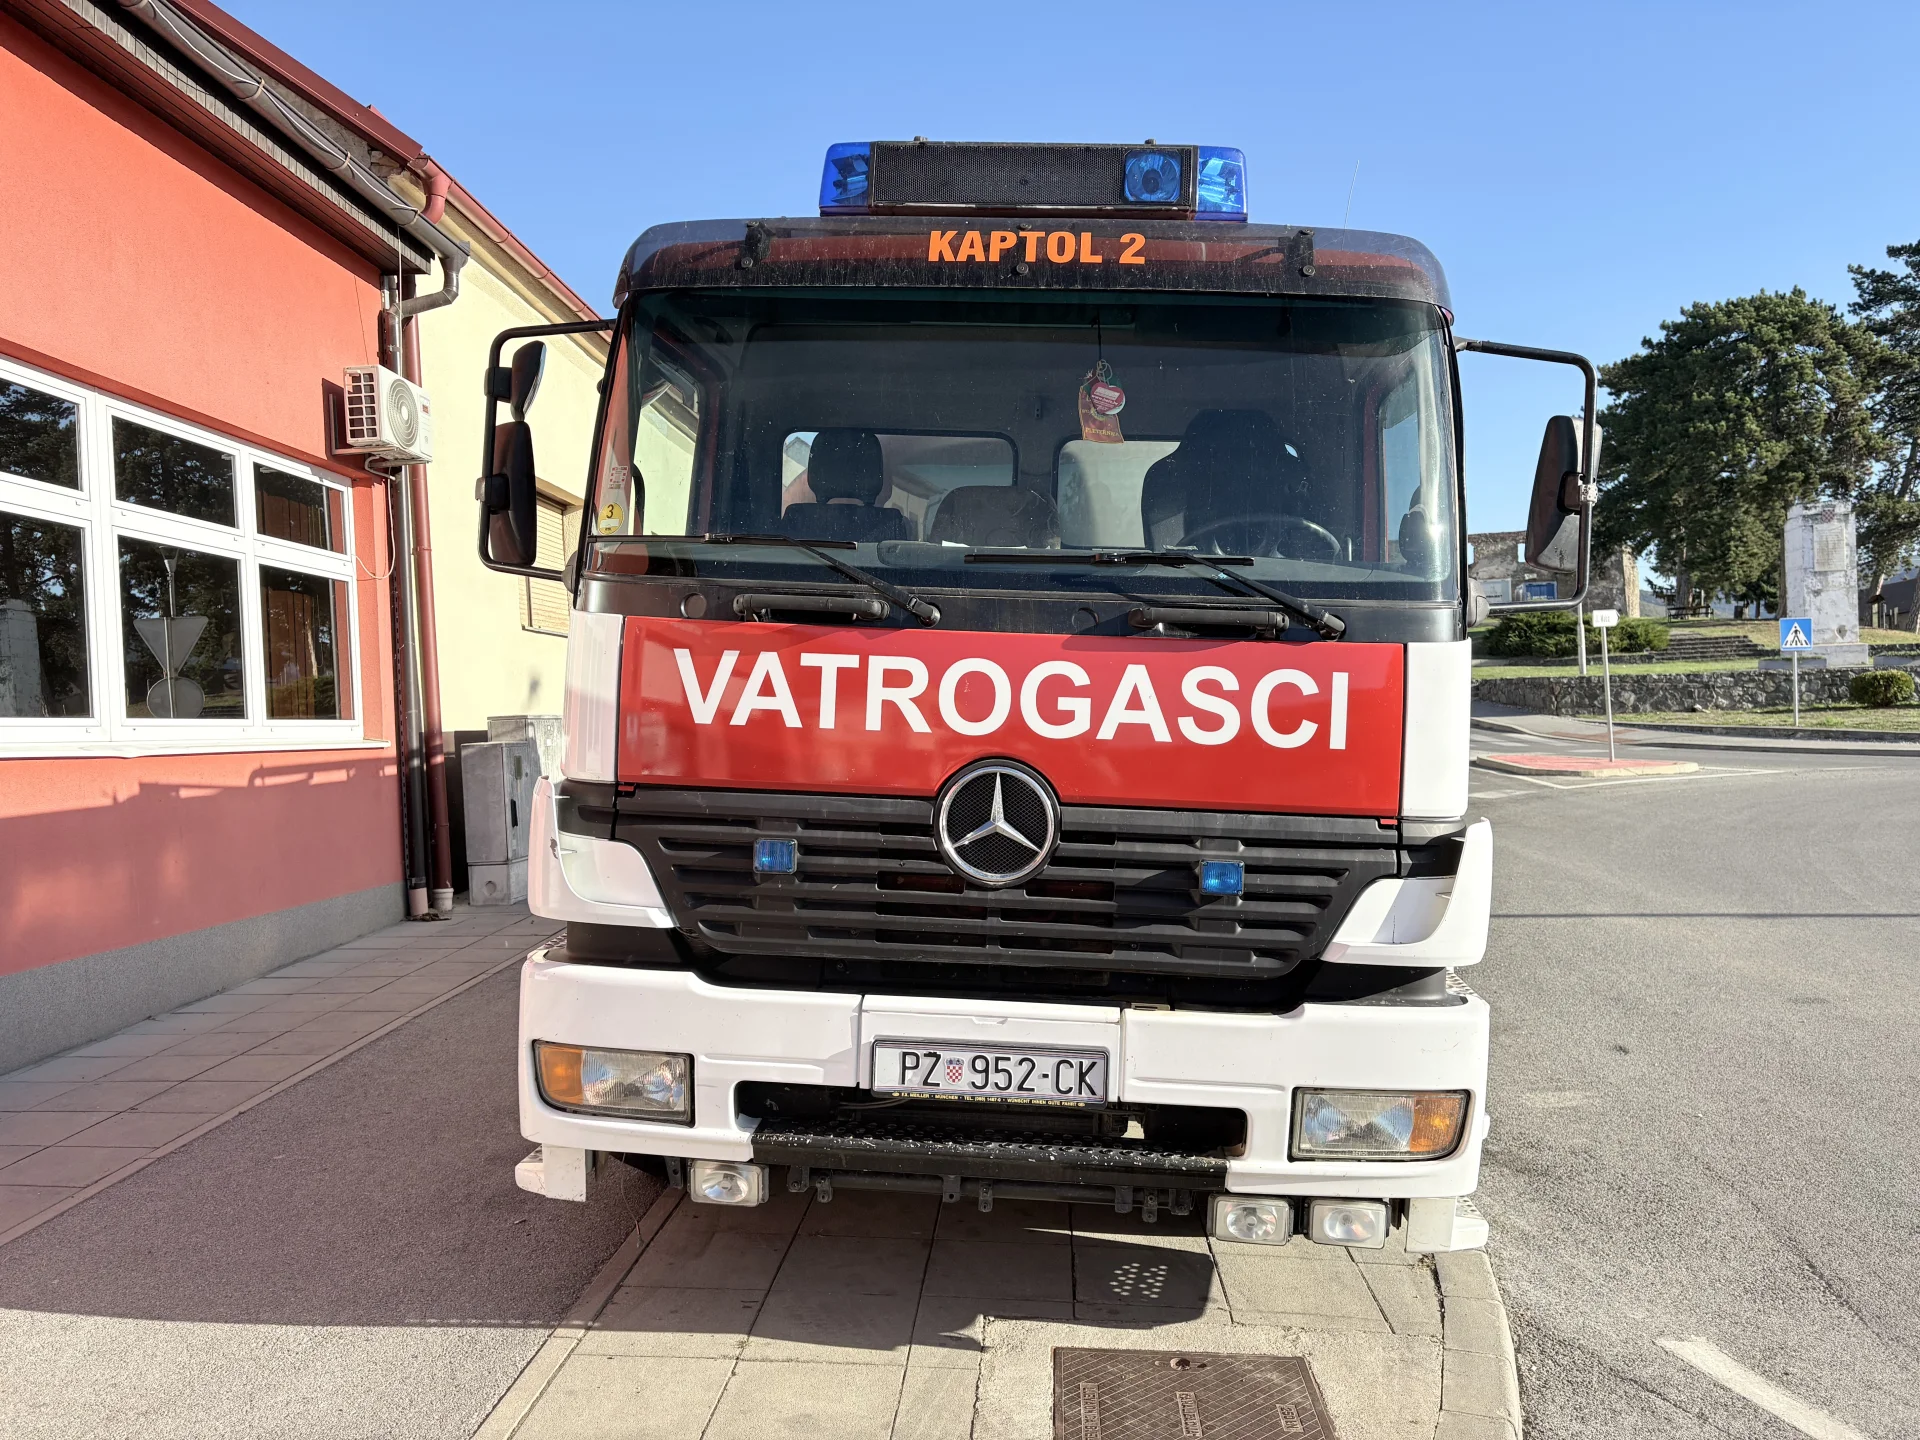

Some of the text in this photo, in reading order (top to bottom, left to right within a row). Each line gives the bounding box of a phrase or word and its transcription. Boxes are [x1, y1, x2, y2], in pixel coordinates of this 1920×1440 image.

[928, 230, 1146, 265] KAPTOL 2
[606, 503, 615, 519] 3
[673, 647, 1349, 751] VATROGASCI
[970, 1054, 1098, 1096] 952-CK
